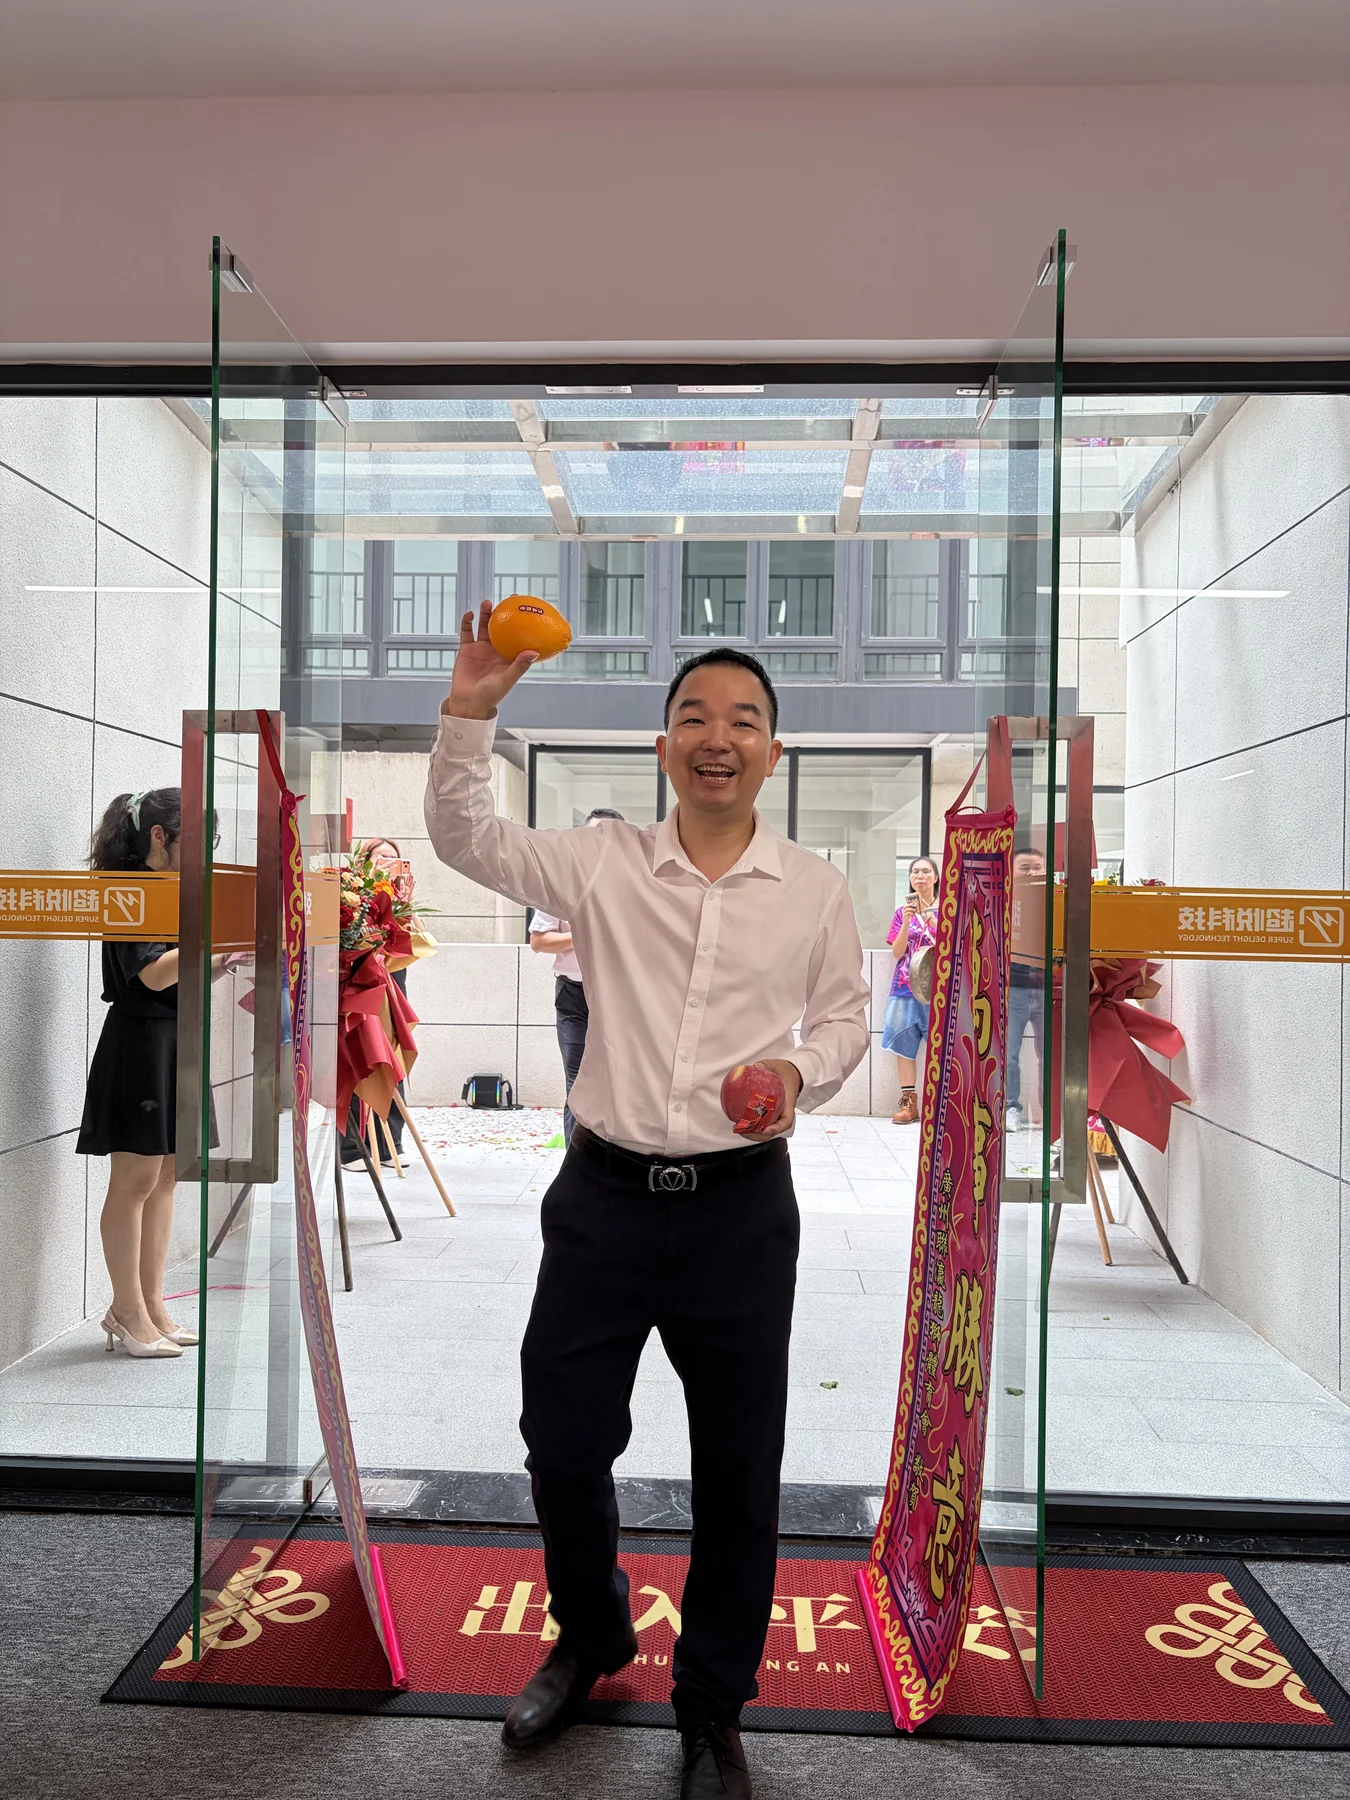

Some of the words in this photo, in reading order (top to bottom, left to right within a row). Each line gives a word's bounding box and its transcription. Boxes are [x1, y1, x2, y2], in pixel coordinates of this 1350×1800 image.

[633, 1654, 667, 1666] HU
[766, 1659, 800, 1672] NG
[816, 1661, 850, 1673] AN
